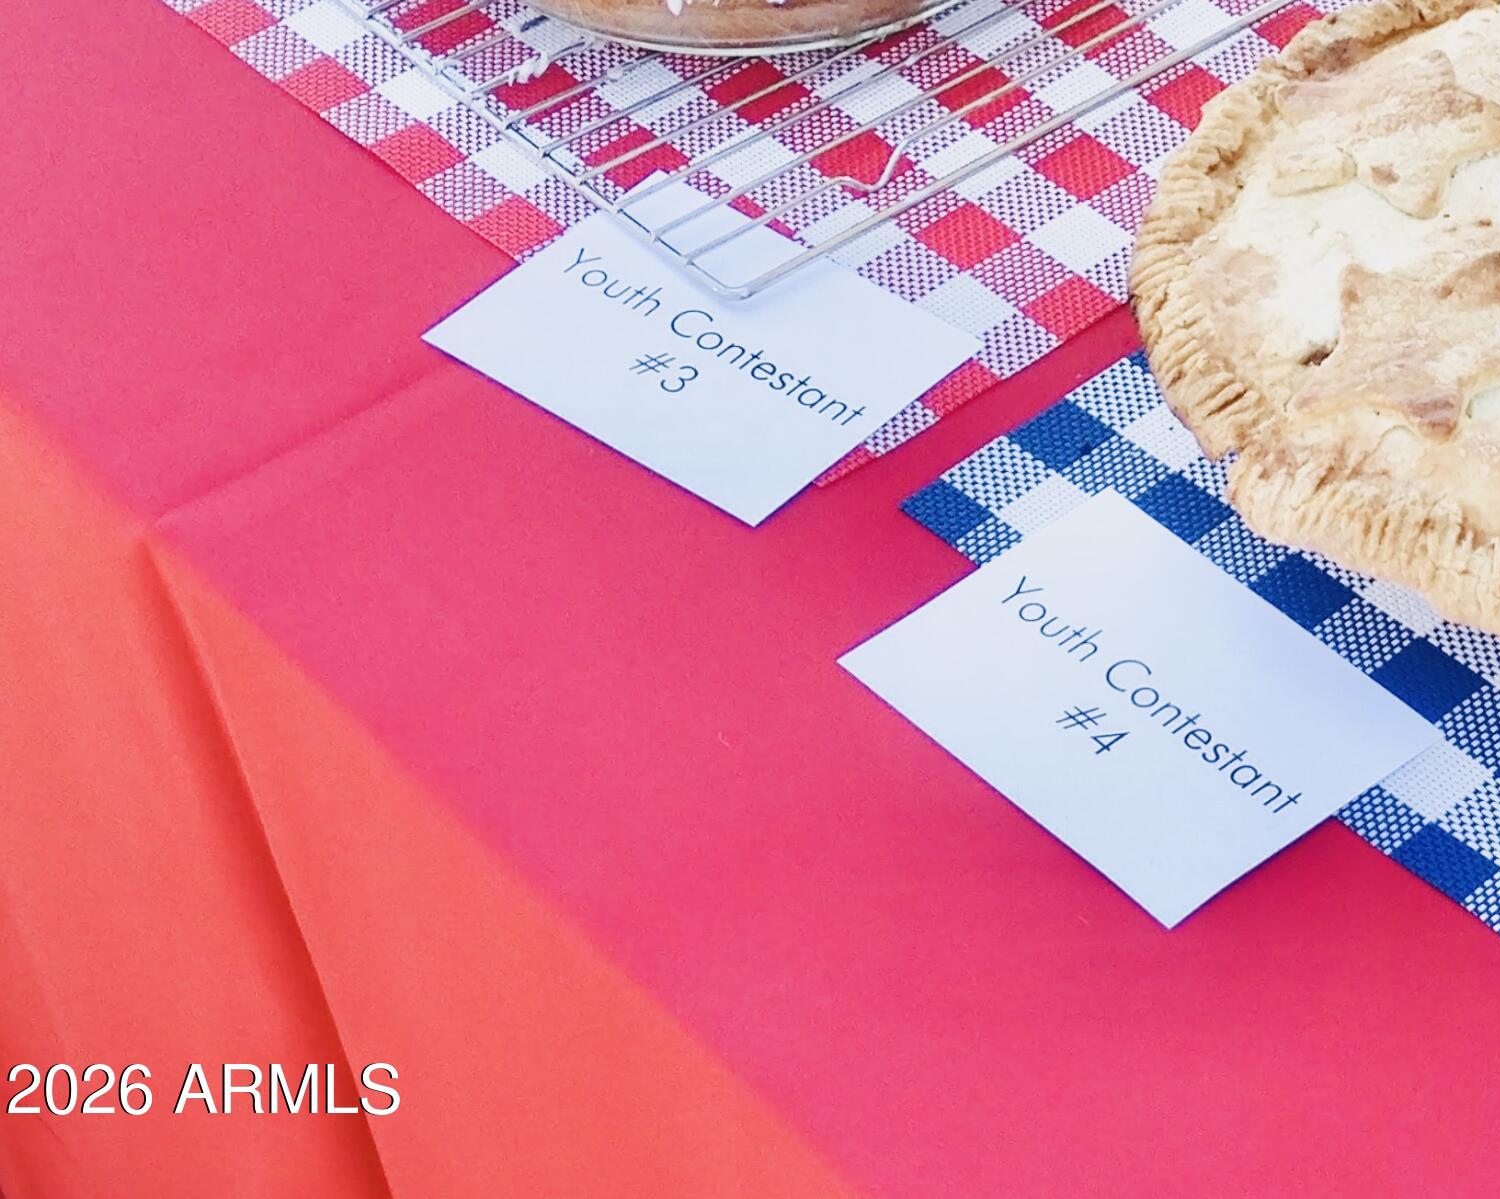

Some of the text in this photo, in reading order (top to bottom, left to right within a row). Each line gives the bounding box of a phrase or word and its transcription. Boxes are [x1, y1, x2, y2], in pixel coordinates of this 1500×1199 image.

[563, 247, 867, 427] Youth Contestant
[628, 351, 700, 394] #3
[1001, 575, 1303, 815] Youth Contestant
[1055, 705, 1131, 756] #4
